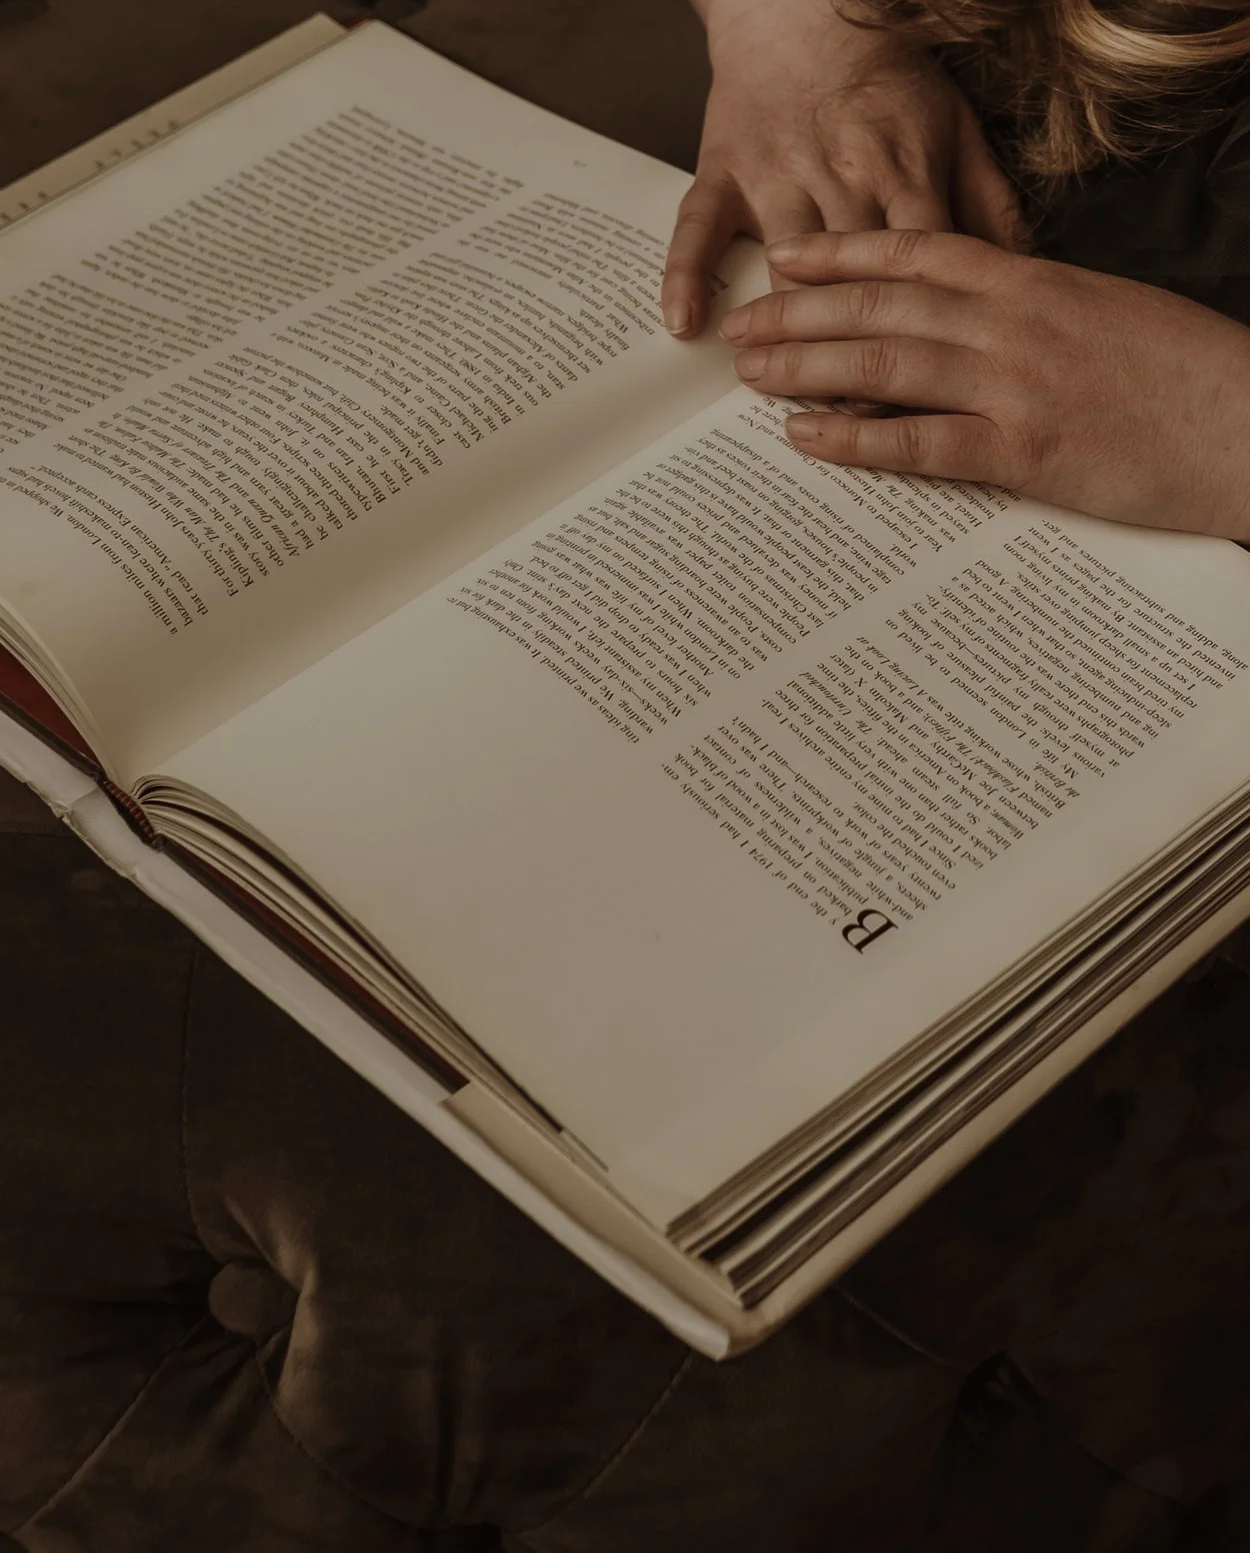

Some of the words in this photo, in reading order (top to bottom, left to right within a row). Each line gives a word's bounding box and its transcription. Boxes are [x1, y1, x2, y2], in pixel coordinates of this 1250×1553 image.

[376, 404, 405, 426] made.
[737, 413, 758, 427] New
[403, 425, 421, 439] get
[754, 424, 775, 435] and
[774, 434, 816, 466] Christmas
[815, 464, 830, 476] for
[829, 474, 867, 506] Morocco
[68, 499, 112, 530] makeshift
[96, 498, 132, 527] Express
[865, 504, 877, 514] to
[66, 513, 101, 545] London.
[874, 511, 911, 542] escaped
[1027, 526, 1050, 545] went
[110, 529, 141, 559] lean-to
[1002, 542, 1026, 562] room
[1017, 539, 1052, 564] myself
[1057, 534, 1078, 549] and
[99, 542, 122, 564] from
[889, 543, 916, 567] world.
[1059, 552, 1071, 561] as
[1078, 549, 1117, 577] pictures
[120, 563, 145, 589] miles
[138, 557, 165, 587] where
[170, 570, 193, 592] read
[1026, 561, 1053, 585] living
[1050, 563, 1080, 585] prints
[1071, 562, 1100, 583] pages
[460, 586, 472, 594] six
[471, 591, 486, 601] for
[1051, 584, 1069, 597] my
[1076, 583, 1111, 611] making
[1099, 583, 1116, 596] the
[1115, 575, 1165, 613] subtracting
[143, 589, 172, 626] million
[163, 587, 193, 626] bazaars
[190, 592, 208, 615] that
[455, 599, 472, 612] but
[484, 597, 505, 611] dark
[1069, 596, 1080, 607] in
[1116, 596, 1132, 608] for
[469, 605, 516, 637] exhausting
[505, 610, 522, 622] the
[521, 620, 533, 631] in
[1081, 605, 1124, 638] darkroom
[1107, 609, 1126, 623] By
[1132, 607, 1174, 637] structure
[1163, 612, 1185, 627] and
[514, 635, 532, 650] was
[531, 629, 567, 656] steadily
[1127, 620, 1166, 649] assistant.
[1175, 636, 1192, 650] the
[1185, 624, 1218, 649] adding
[529, 647, 541, 658] It
[1121, 637, 1150, 656] small
[1165, 648, 1179, 658] an
[539, 655, 578, 685] printed.
[563, 656, 602, 684] printed
[1158, 661, 1172, 673] up
[1175, 657, 1204, 678] hired
[1191, 649, 1235, 681] invented
[1220, 648, 1248, 670] along,
[1172, 671, 1189, 684] set
[1201, 674, 1223, 689] and
[573, 683, 588, 698] we
[586, 695, 599, 706] as
[599, 684, 615, 701] We
[596, 704, 622, 728] ideas
[617, 699, 653, 734] warding.
[619, 723, 639, 743] ting
[716, 725, 739, 744] over
[703, 734, 736, 765] contact
[739, 745, 757, 762] was
[674, 752, 698, 776] book
[714, 769, 728, 780] of
[736, 767, 751, 778] of
[699, 777, 715, 791] for
[758, 763, 786, 789] There
[680, 782, 720, 819] seriously
[725, 779, 752, 803] wood
[715, 792, 754, 827] material
[753, 781, 800, 824] wilderness
[792, 790, 839, 836] workprints.
[832, 807, 844, 818] to
[852, 801, 877, 824] color.
[759, 808, 771, 820] in
[719, 820, 741, 839] had
[769, 818, 788, 836] lost
[844, 817, 868, 839] work
[876, 823, 894, 839] the
[756, 828, 803, 869] preparing
[788, 834, 805, 851] was
[838, 836, 852, 847] of
[866, 839, 881, 850] of
[749, 847, 773, 869] 1974
[818, 836, 862, 877] negatives,
[853, 848, 887, 875] jungle
[881, 849, 908, 872] years
[890, 837, 931, 870] touched
[774, 870, 787, 880] of
[803, 870, 816, 883] on
[815, 856, 869, 904] publication.
[908, 871, 941, 900] twenty
[931, 868, 955, 889] even
[786, 881, 808, 899] end
[817, 885, 852, 916] barked
[865, 880, 913, 920] and-white
[896, 881, 925, 910] sheets,
[809, 901, 827, 916] the
